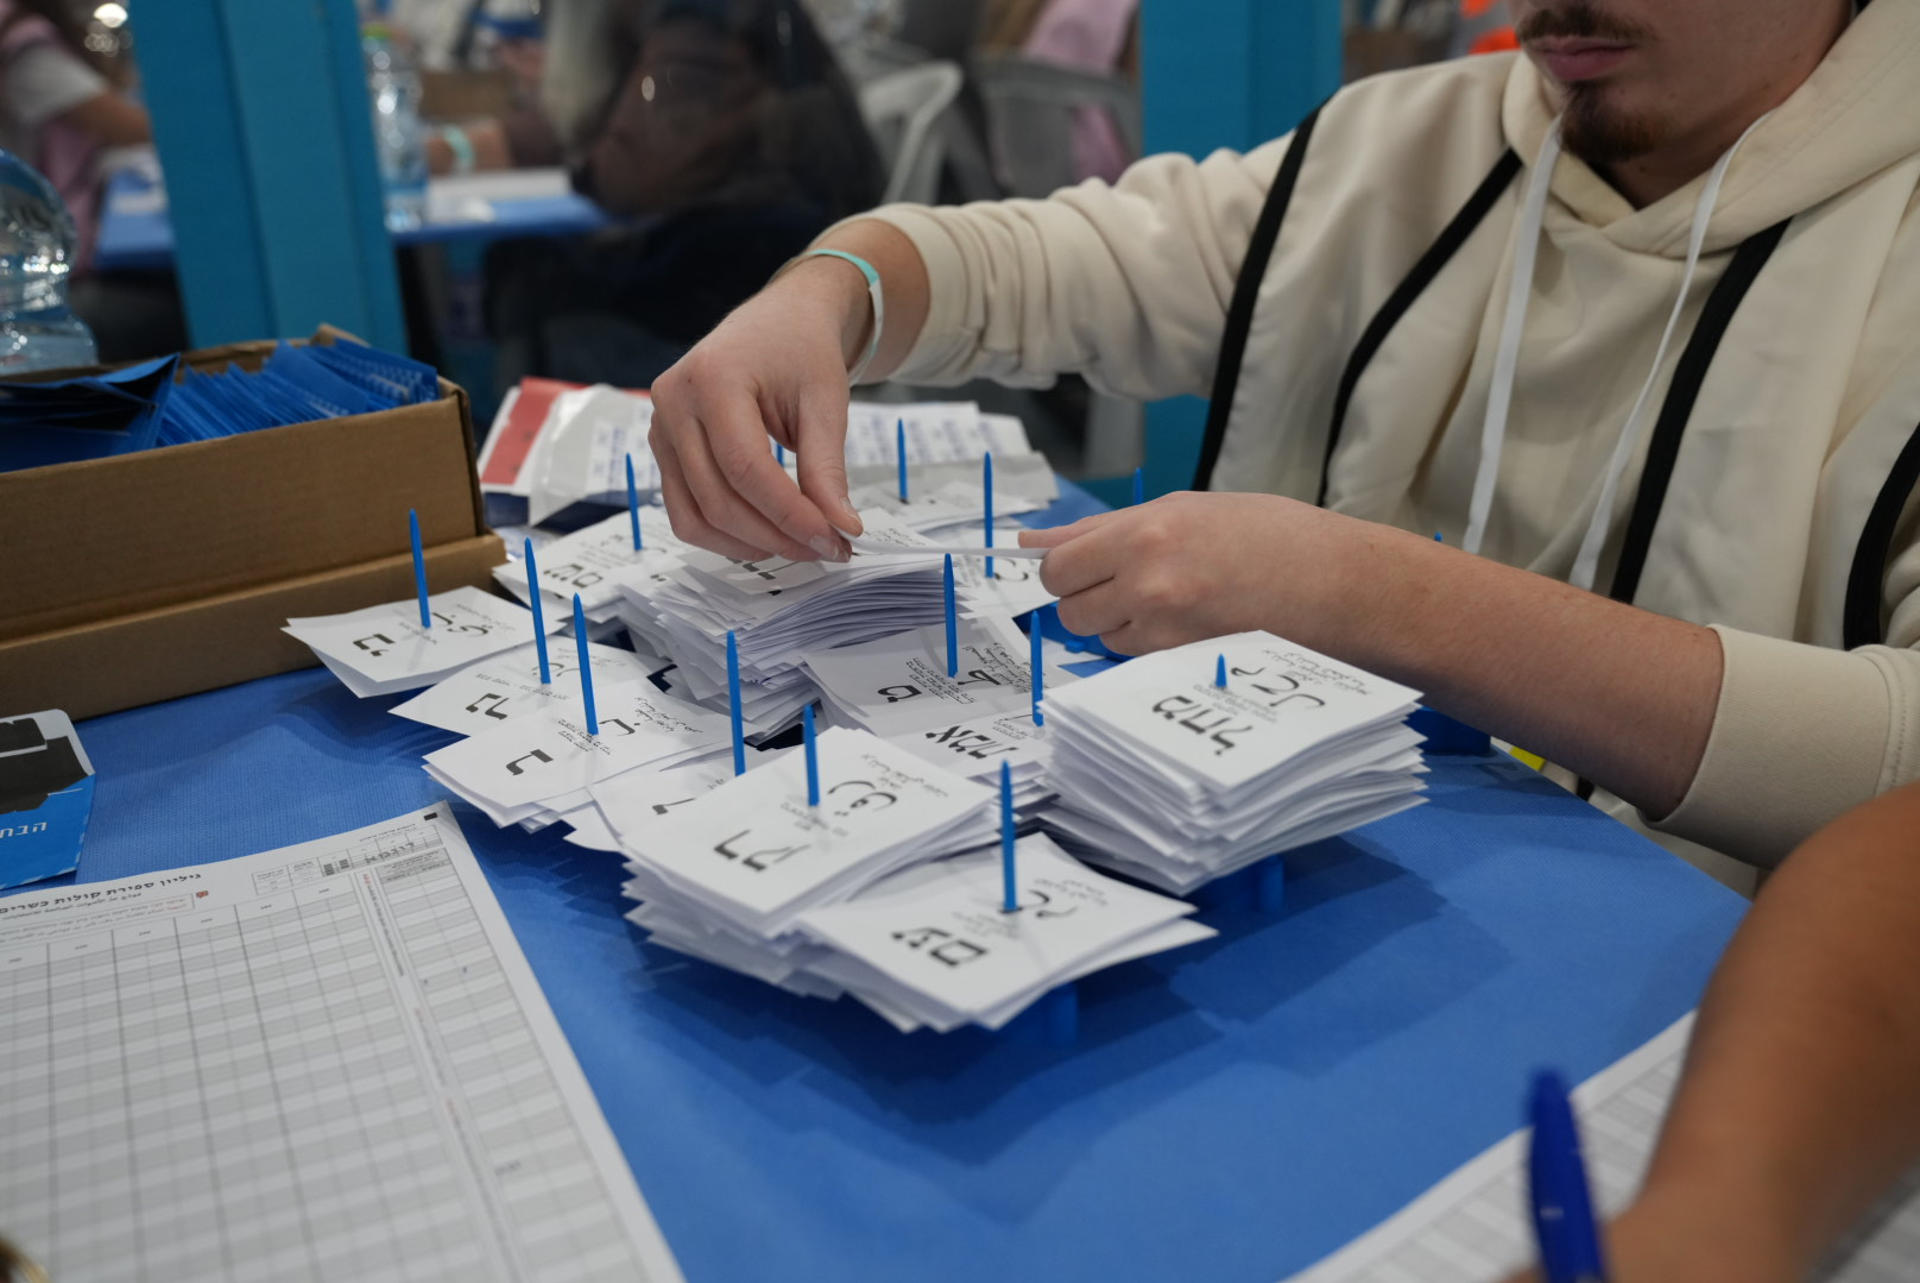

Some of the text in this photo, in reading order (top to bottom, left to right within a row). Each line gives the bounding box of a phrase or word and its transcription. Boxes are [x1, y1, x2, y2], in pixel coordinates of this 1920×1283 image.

[465, 692, 509, 720] נר
[925, 725, 1019, 759] אמת
[1152, 695, 1253, 756] מחל
[891, 927, 989, 967] עם
